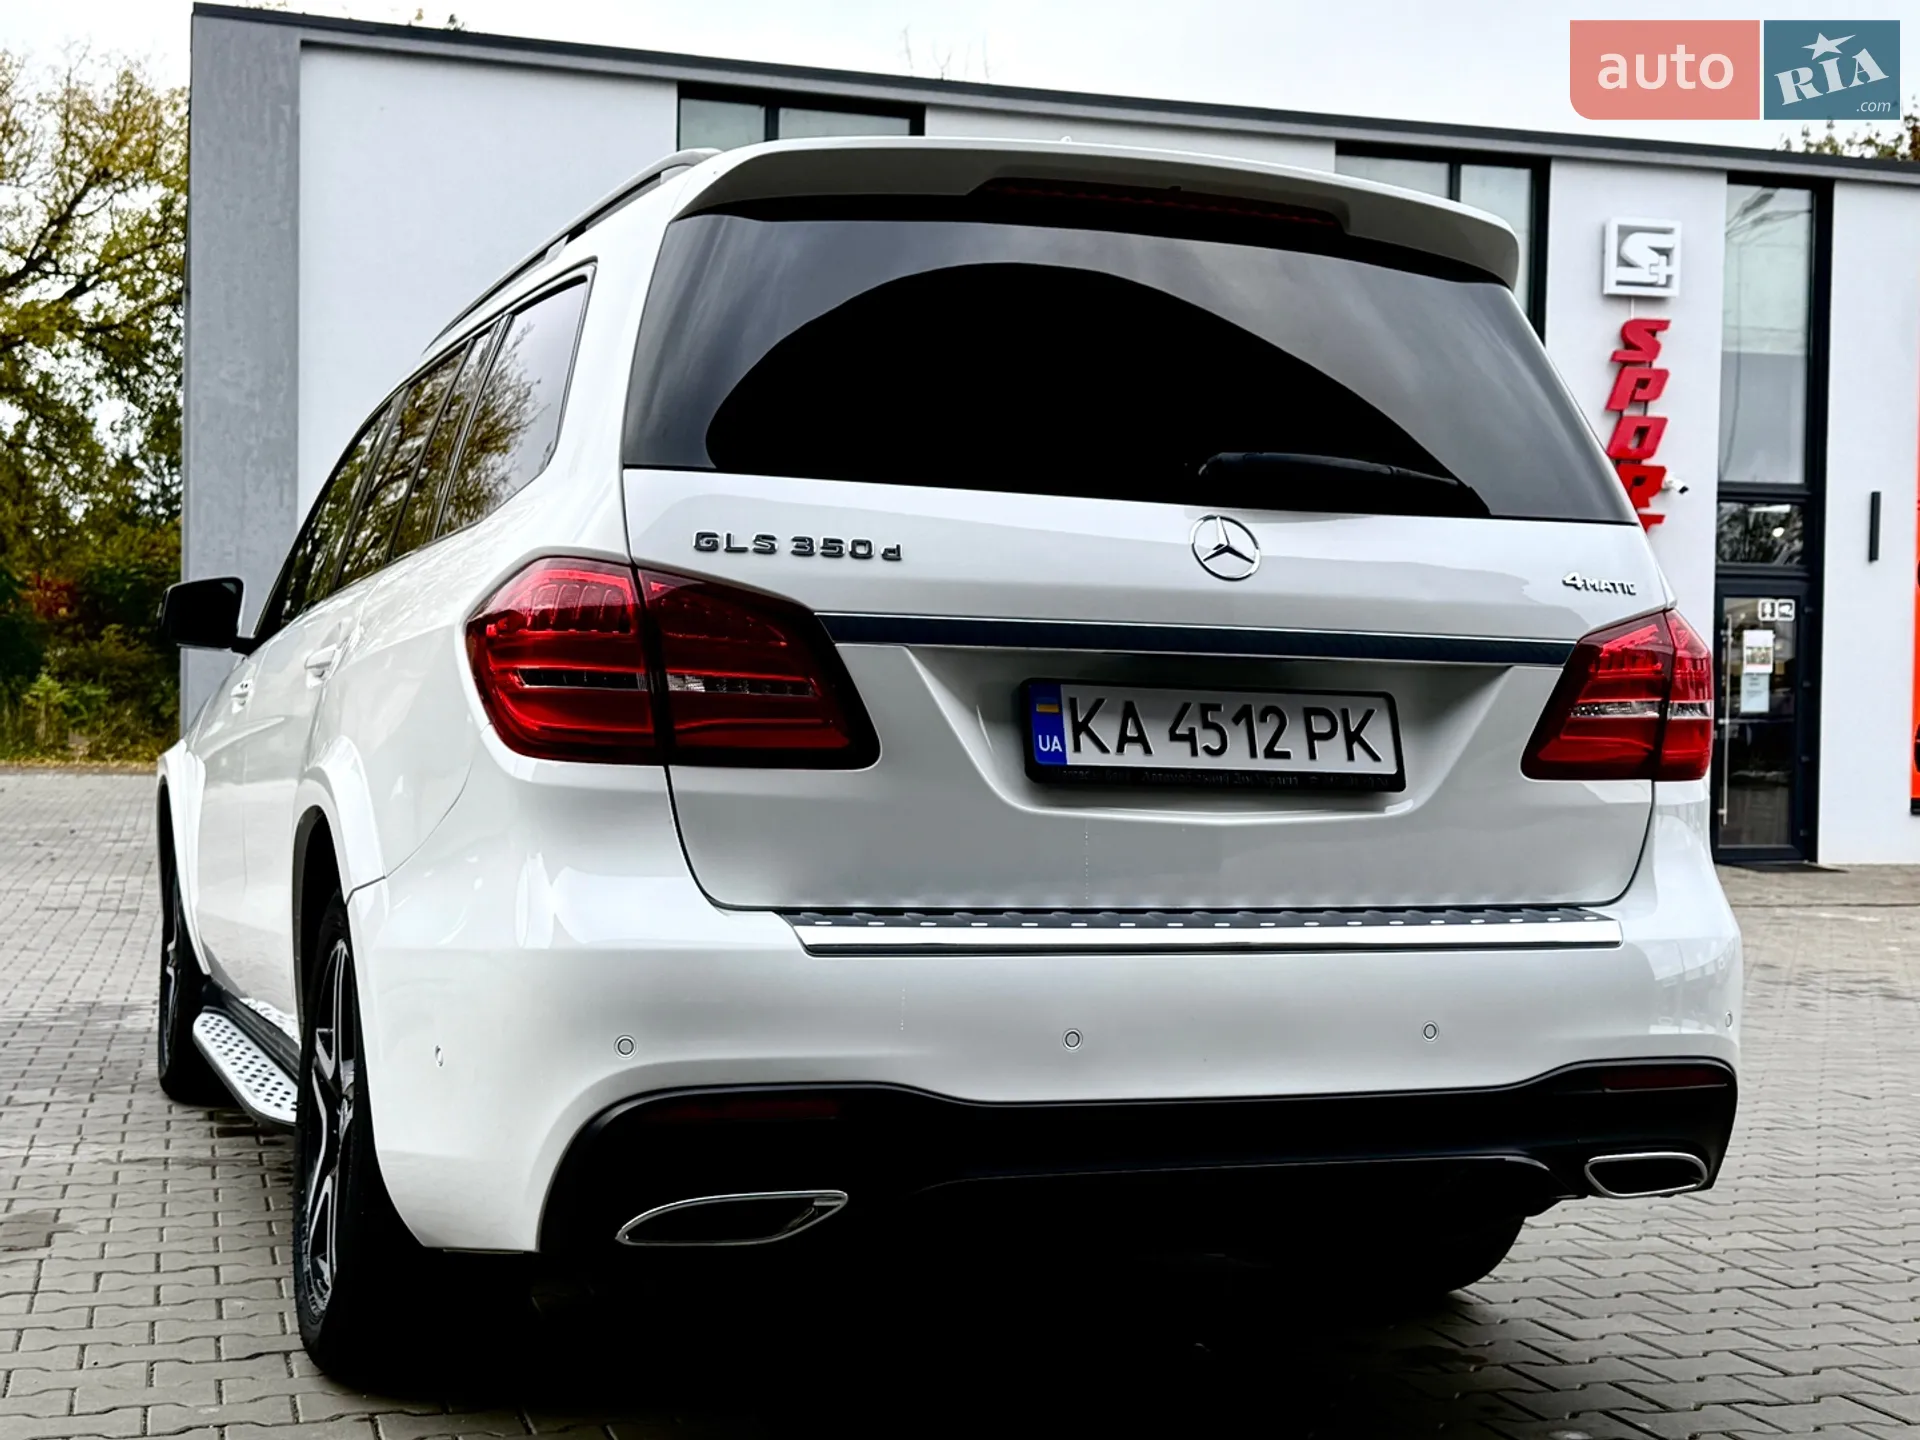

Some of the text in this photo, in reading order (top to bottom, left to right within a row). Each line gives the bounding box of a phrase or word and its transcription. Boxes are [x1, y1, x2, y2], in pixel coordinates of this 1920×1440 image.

[694, 531, 778, 555] GLS
[1561, 572, 1637, 596] 4MATIC
[1068, 696, 1383, 763] KA 4512 PK
[1038, 733, 1063, 754] UA
